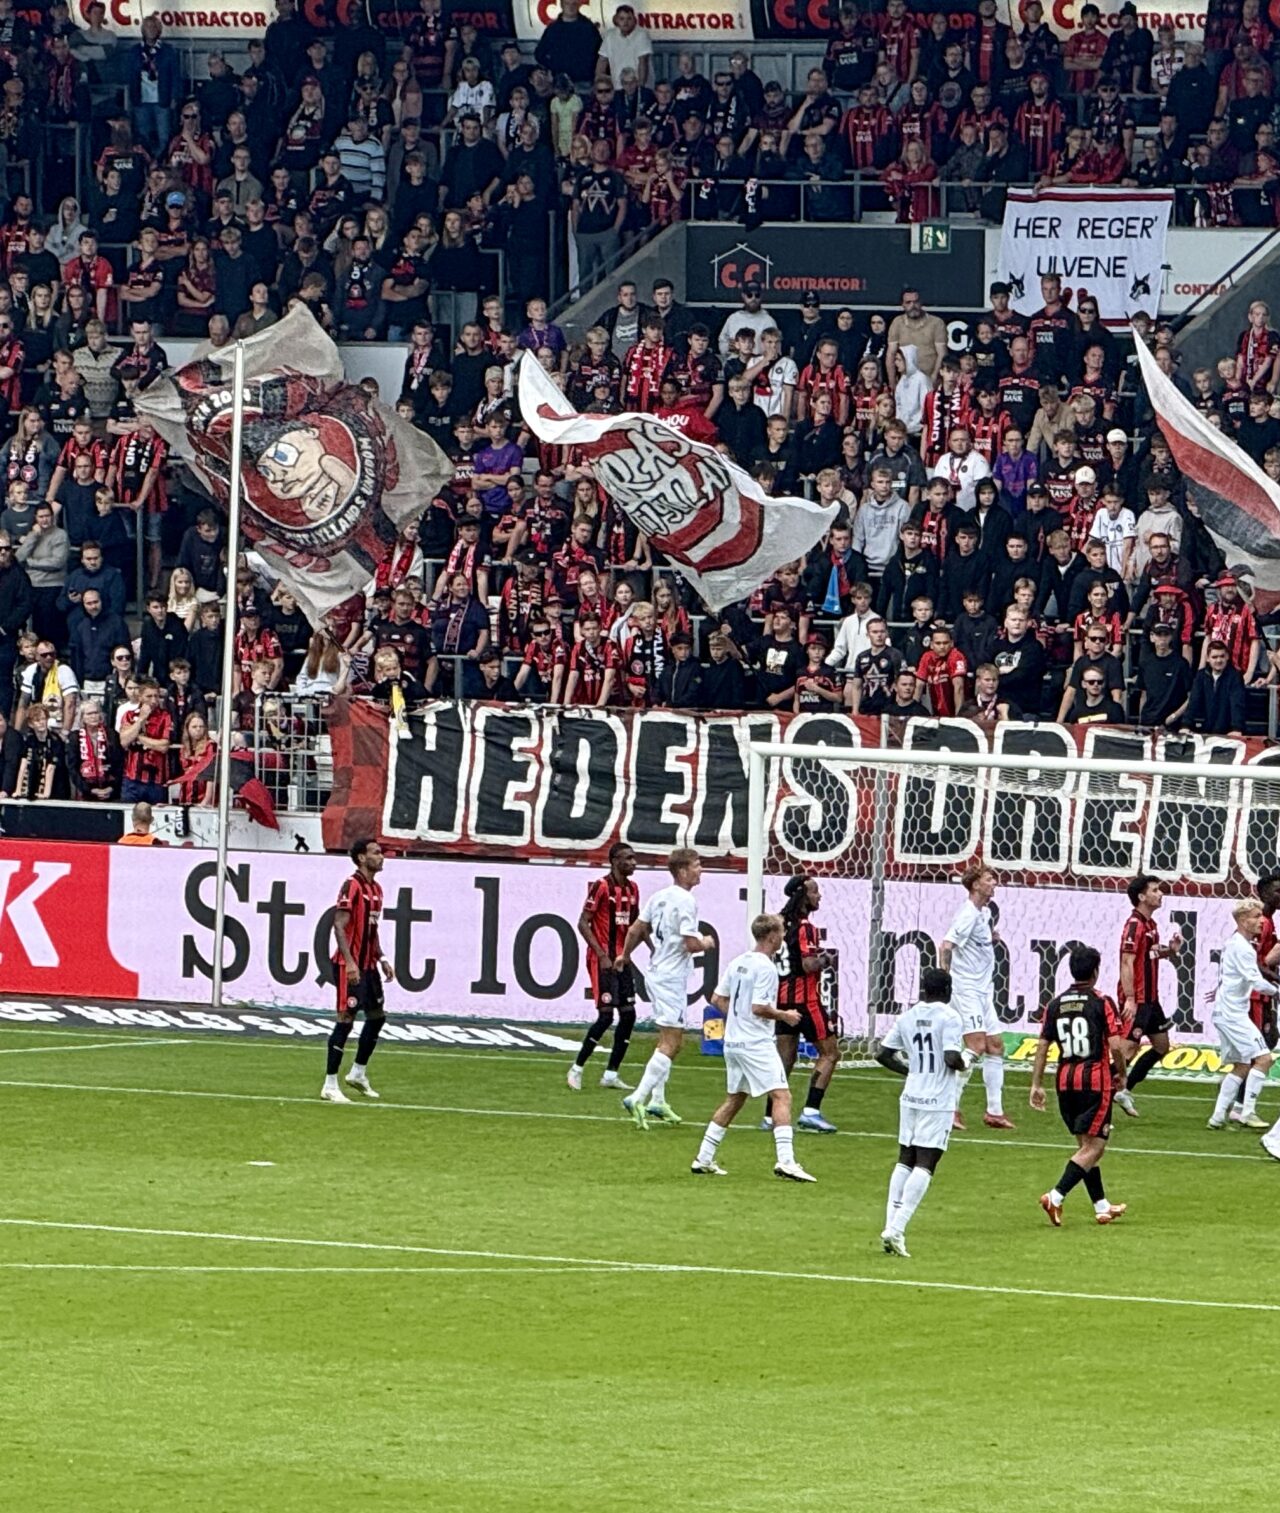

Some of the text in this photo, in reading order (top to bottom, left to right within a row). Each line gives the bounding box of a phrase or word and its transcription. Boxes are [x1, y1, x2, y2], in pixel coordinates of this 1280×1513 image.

[1013, 216, 1061, 239] HER
[1036, 255, 1128, 278] ULVENE
[774, 276, 860, 291] CONTRACTOR
[381, 702, 861, 863] HEDENS
[62, 1004, 245, 1032] HOLD
[238, 1014, 535, 1047] SAMEN
[969, 1015, 984, 1029] 19
[1056, 1016, 1090, 1059] 58
[913, 1032, 935, 1074] 11
